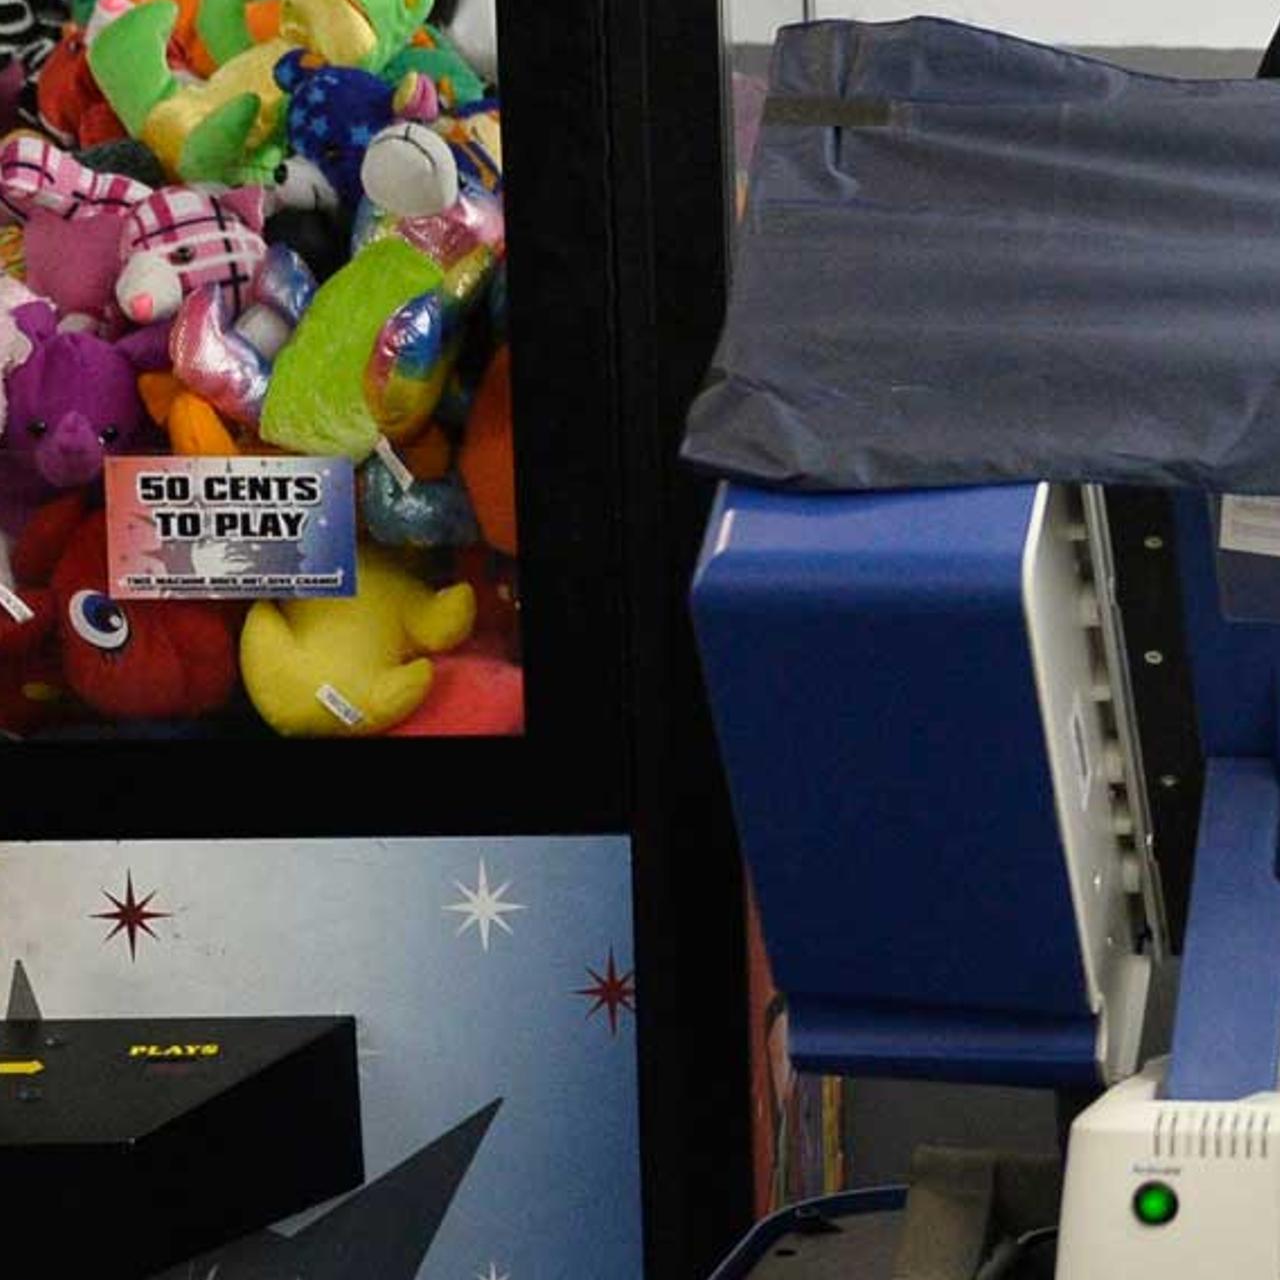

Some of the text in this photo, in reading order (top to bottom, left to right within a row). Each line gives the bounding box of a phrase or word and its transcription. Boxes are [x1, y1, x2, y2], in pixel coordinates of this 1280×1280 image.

[138, 475, 319, 503] 50 CENTS
[156, 511, 305, 538] TO PLAY
[129, 1044, 220, 1056] PLAYS
